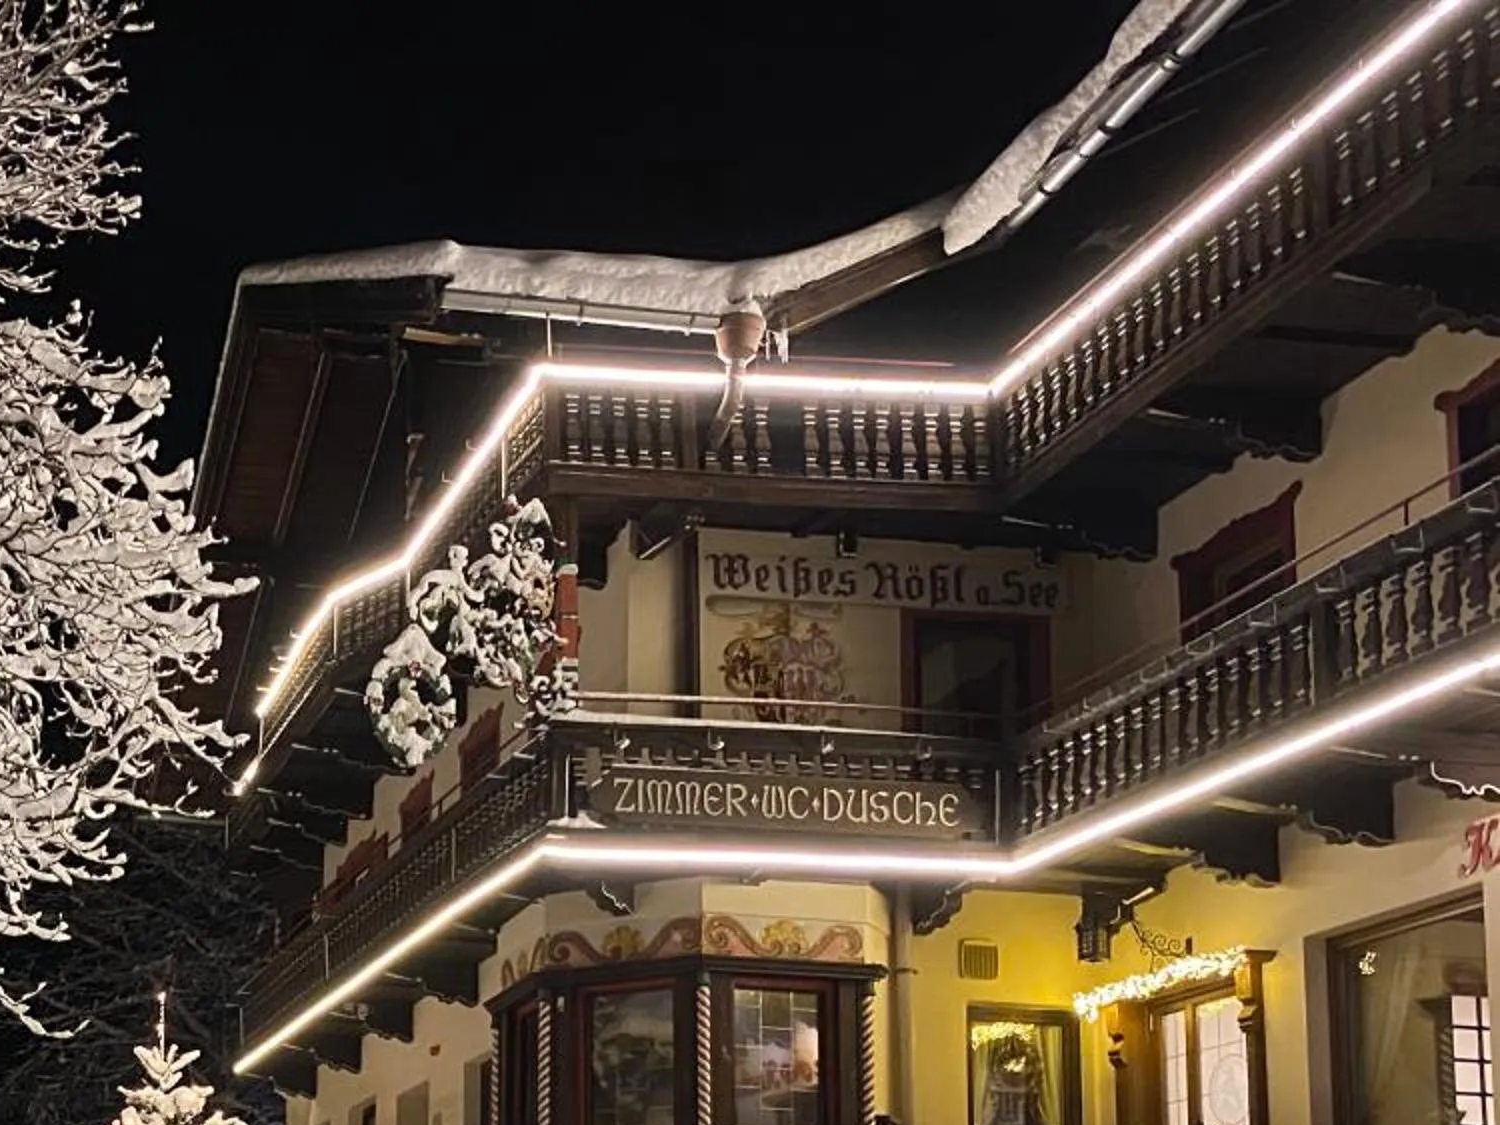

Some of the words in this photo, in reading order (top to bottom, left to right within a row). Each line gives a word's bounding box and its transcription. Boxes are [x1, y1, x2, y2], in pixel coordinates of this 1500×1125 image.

[706, 553, 857, 598] Weißes
[865, 560, 965, 607] Rößl
[1001, 569, 1060, 609] See
[613, 777, 747, 817] ZIMMER
[761, 785, 809, 819] WC
